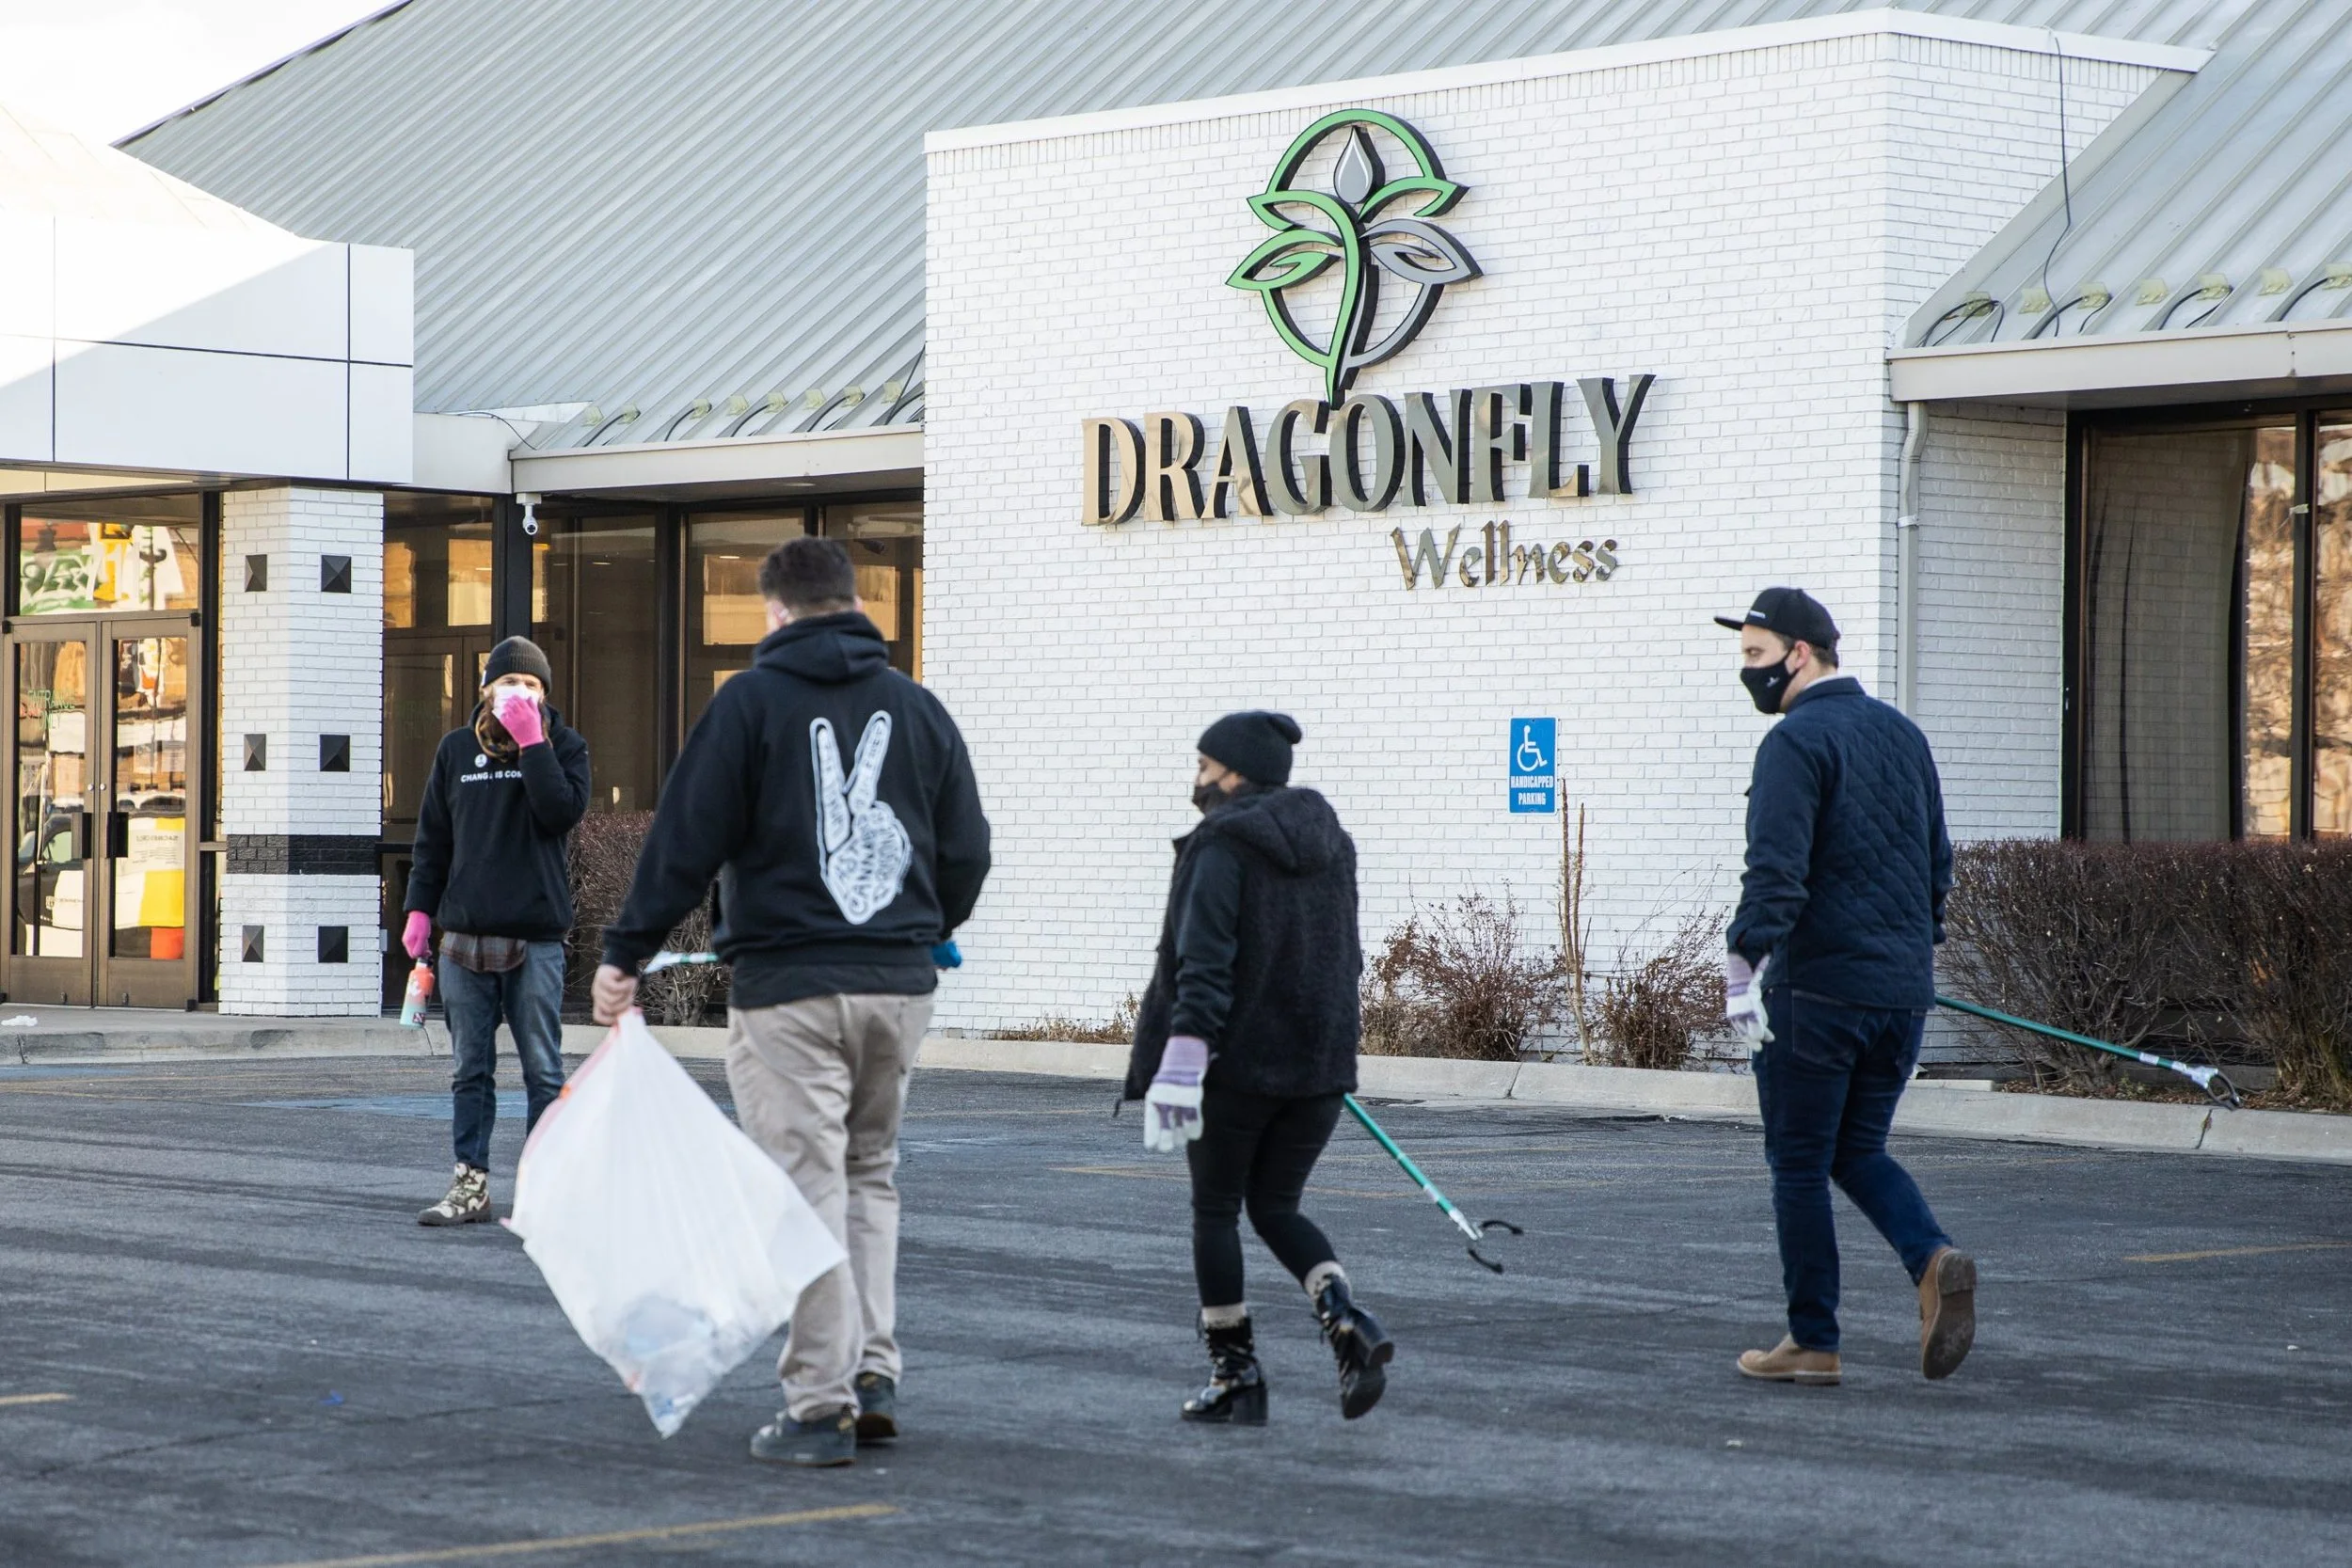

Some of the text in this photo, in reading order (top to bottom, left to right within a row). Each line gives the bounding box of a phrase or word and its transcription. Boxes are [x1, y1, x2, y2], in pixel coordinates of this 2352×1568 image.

[1081, 374, 1656, 526] DRAGONFLY
[1390, 519, 1618, 591] Wellness
[495, 770, 503, 779] IS
[1510, 775, 1554, 788] HANDICAPPED
[1518, 793, 1547, 805] PARKING
